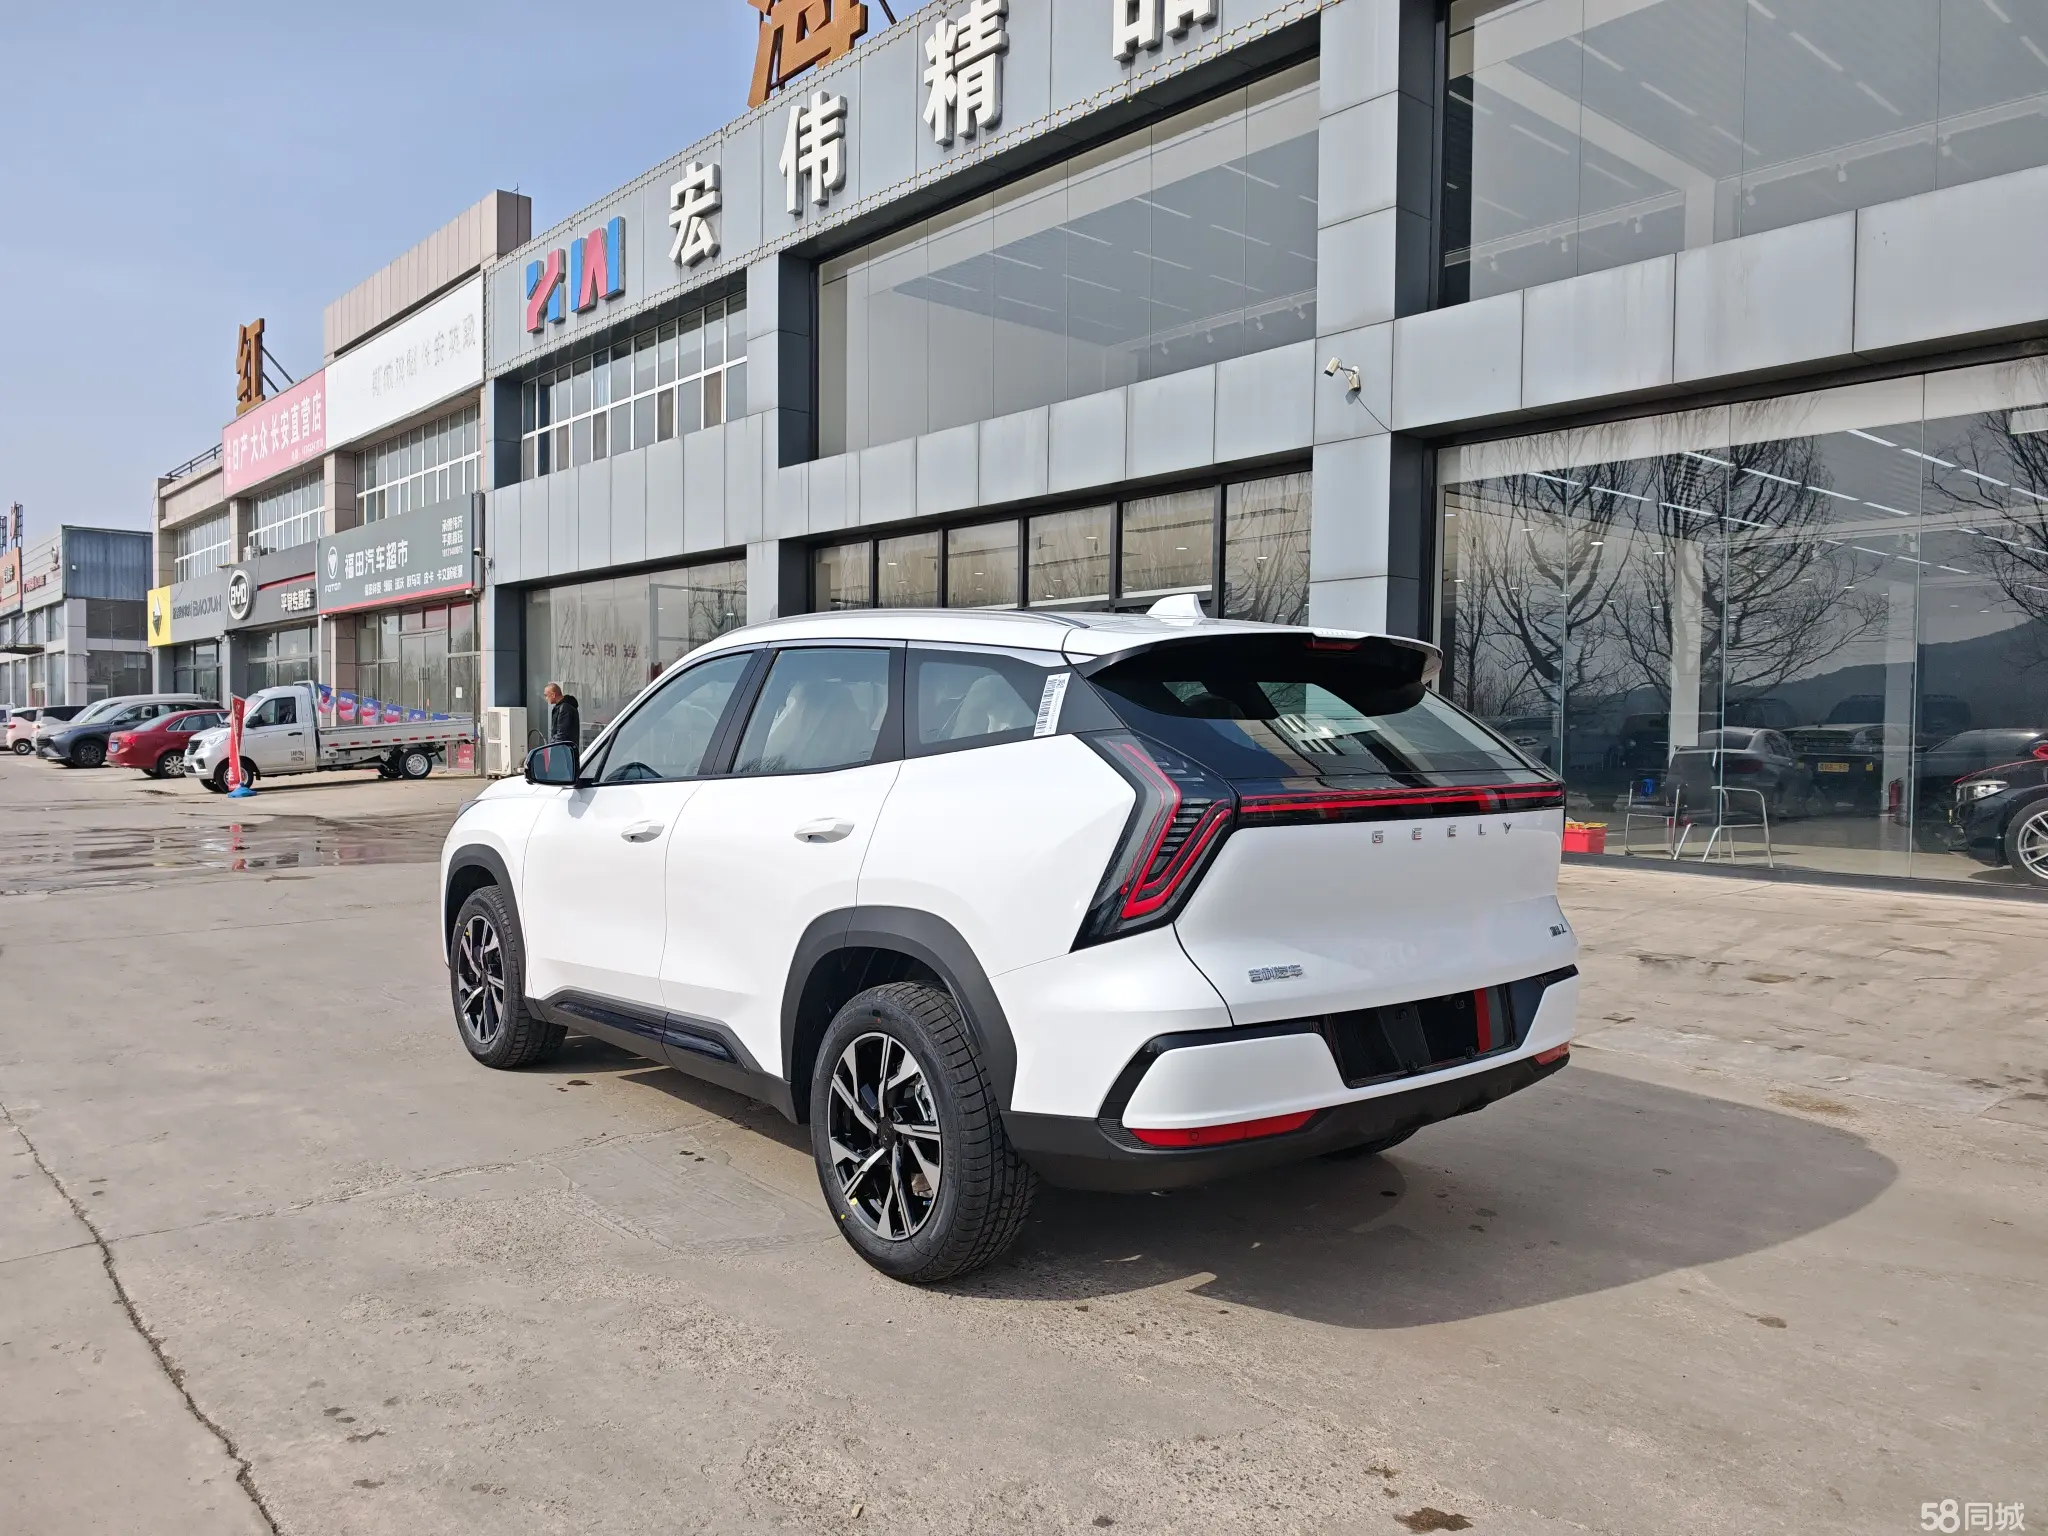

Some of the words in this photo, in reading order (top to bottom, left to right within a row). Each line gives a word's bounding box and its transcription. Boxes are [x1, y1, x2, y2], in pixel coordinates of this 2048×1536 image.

[236, 318, 265, 416] 红
[344, 539, 408, 580] 福田汽车超市
[230, 582, 247, 606] BYD
[280, 588, 312, 612] 平泉专营店
[1371, 822, 1513, 844] GEELY
